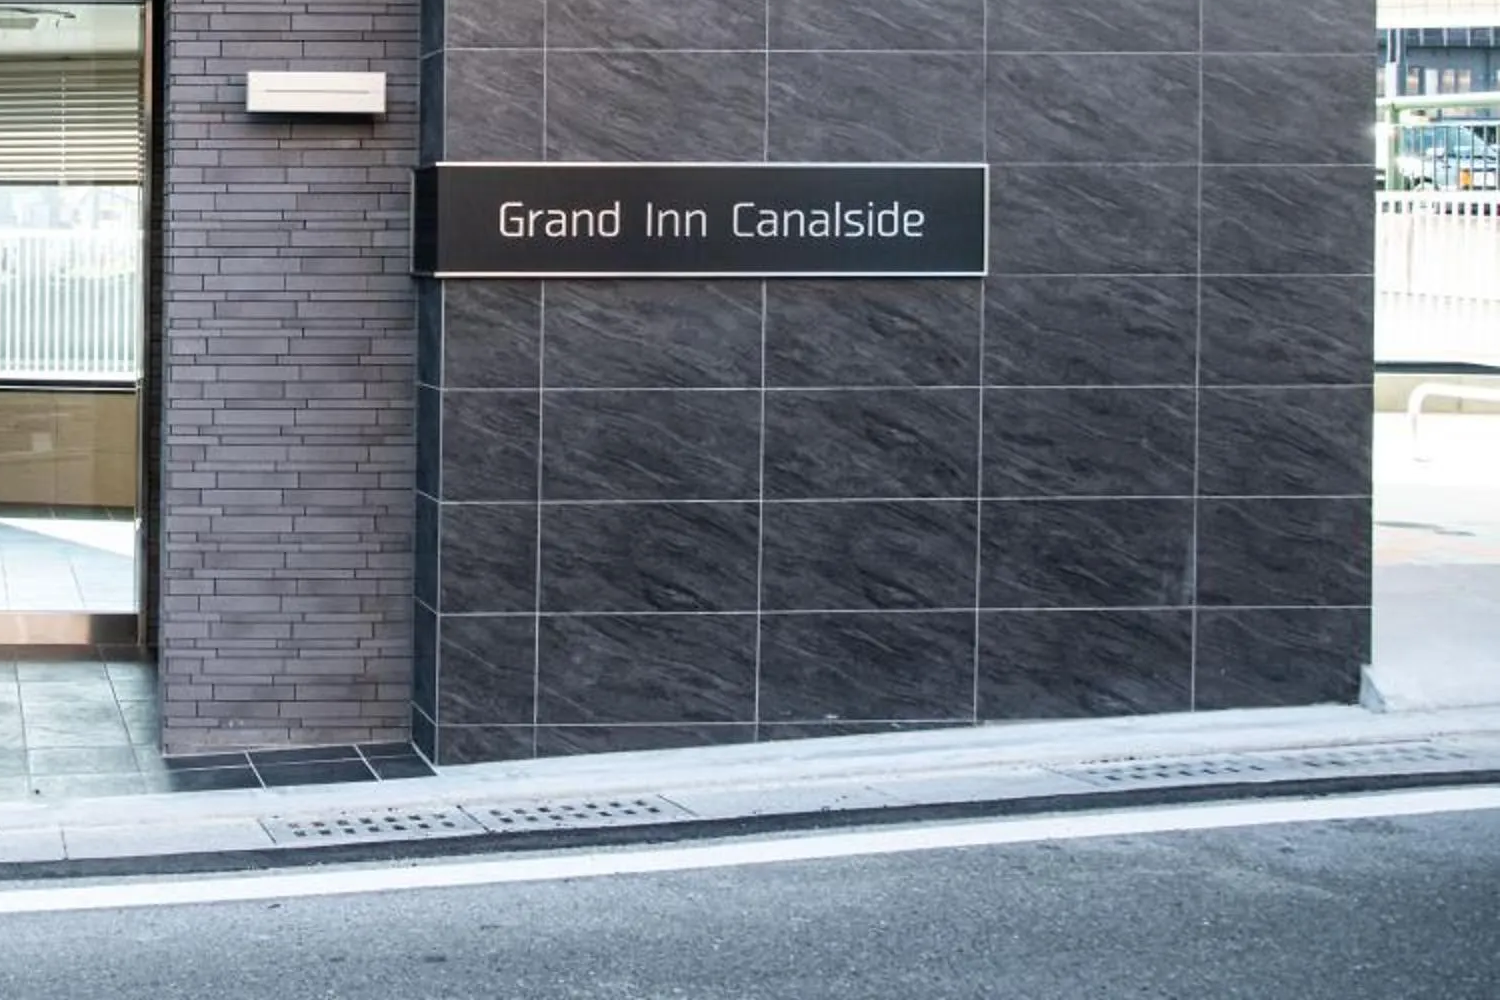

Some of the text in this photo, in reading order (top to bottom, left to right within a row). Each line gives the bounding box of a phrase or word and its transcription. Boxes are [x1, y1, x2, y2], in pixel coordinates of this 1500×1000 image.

[499, 200, 926, 238] Grand Inn Canalside
